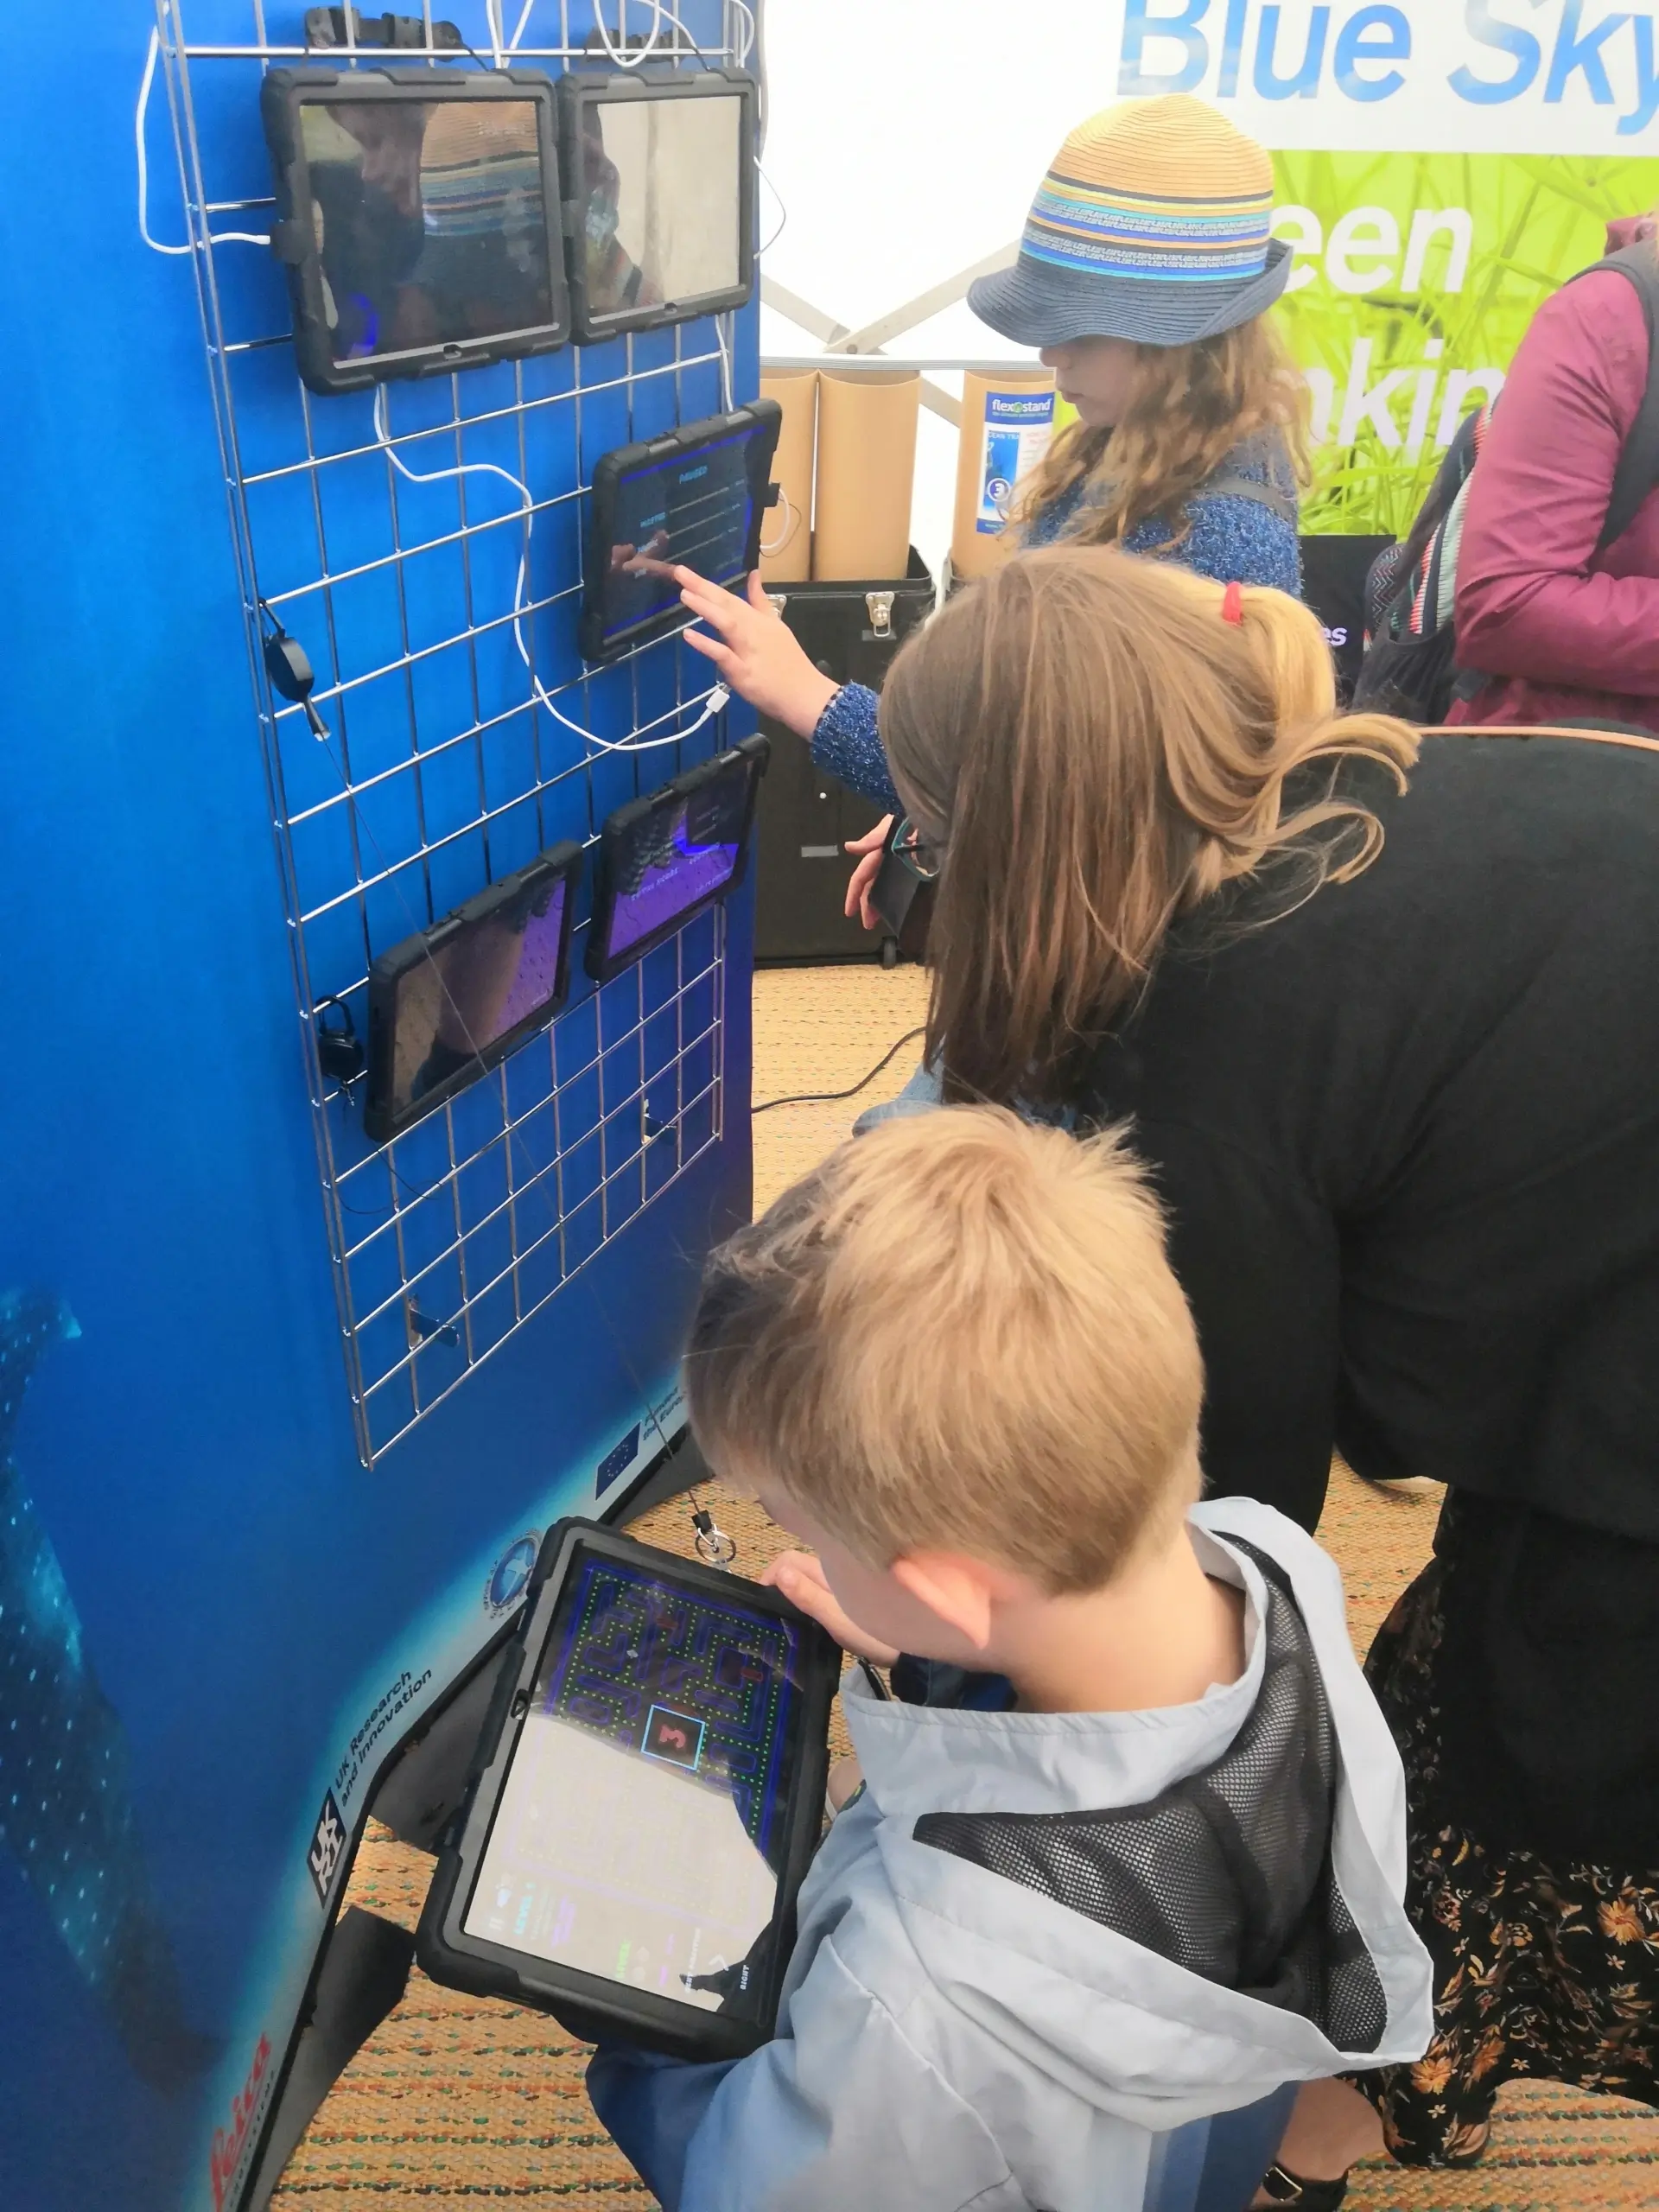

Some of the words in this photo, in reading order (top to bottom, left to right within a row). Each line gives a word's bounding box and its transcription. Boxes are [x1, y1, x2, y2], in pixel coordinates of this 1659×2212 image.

[1116, 0, 1412, 103] Blue
[1446, 0, 1659, 136] Sky
[994, 483, 1005, 496] 3
[335, 1754, 349, 1789] UK
[350, 1671, 411, 1756] Research
[341, 1761, 359, 1807] and
[358, 1669, 432, 1764] Innovation
[740, 1964, 750, 1991] RIGHT
